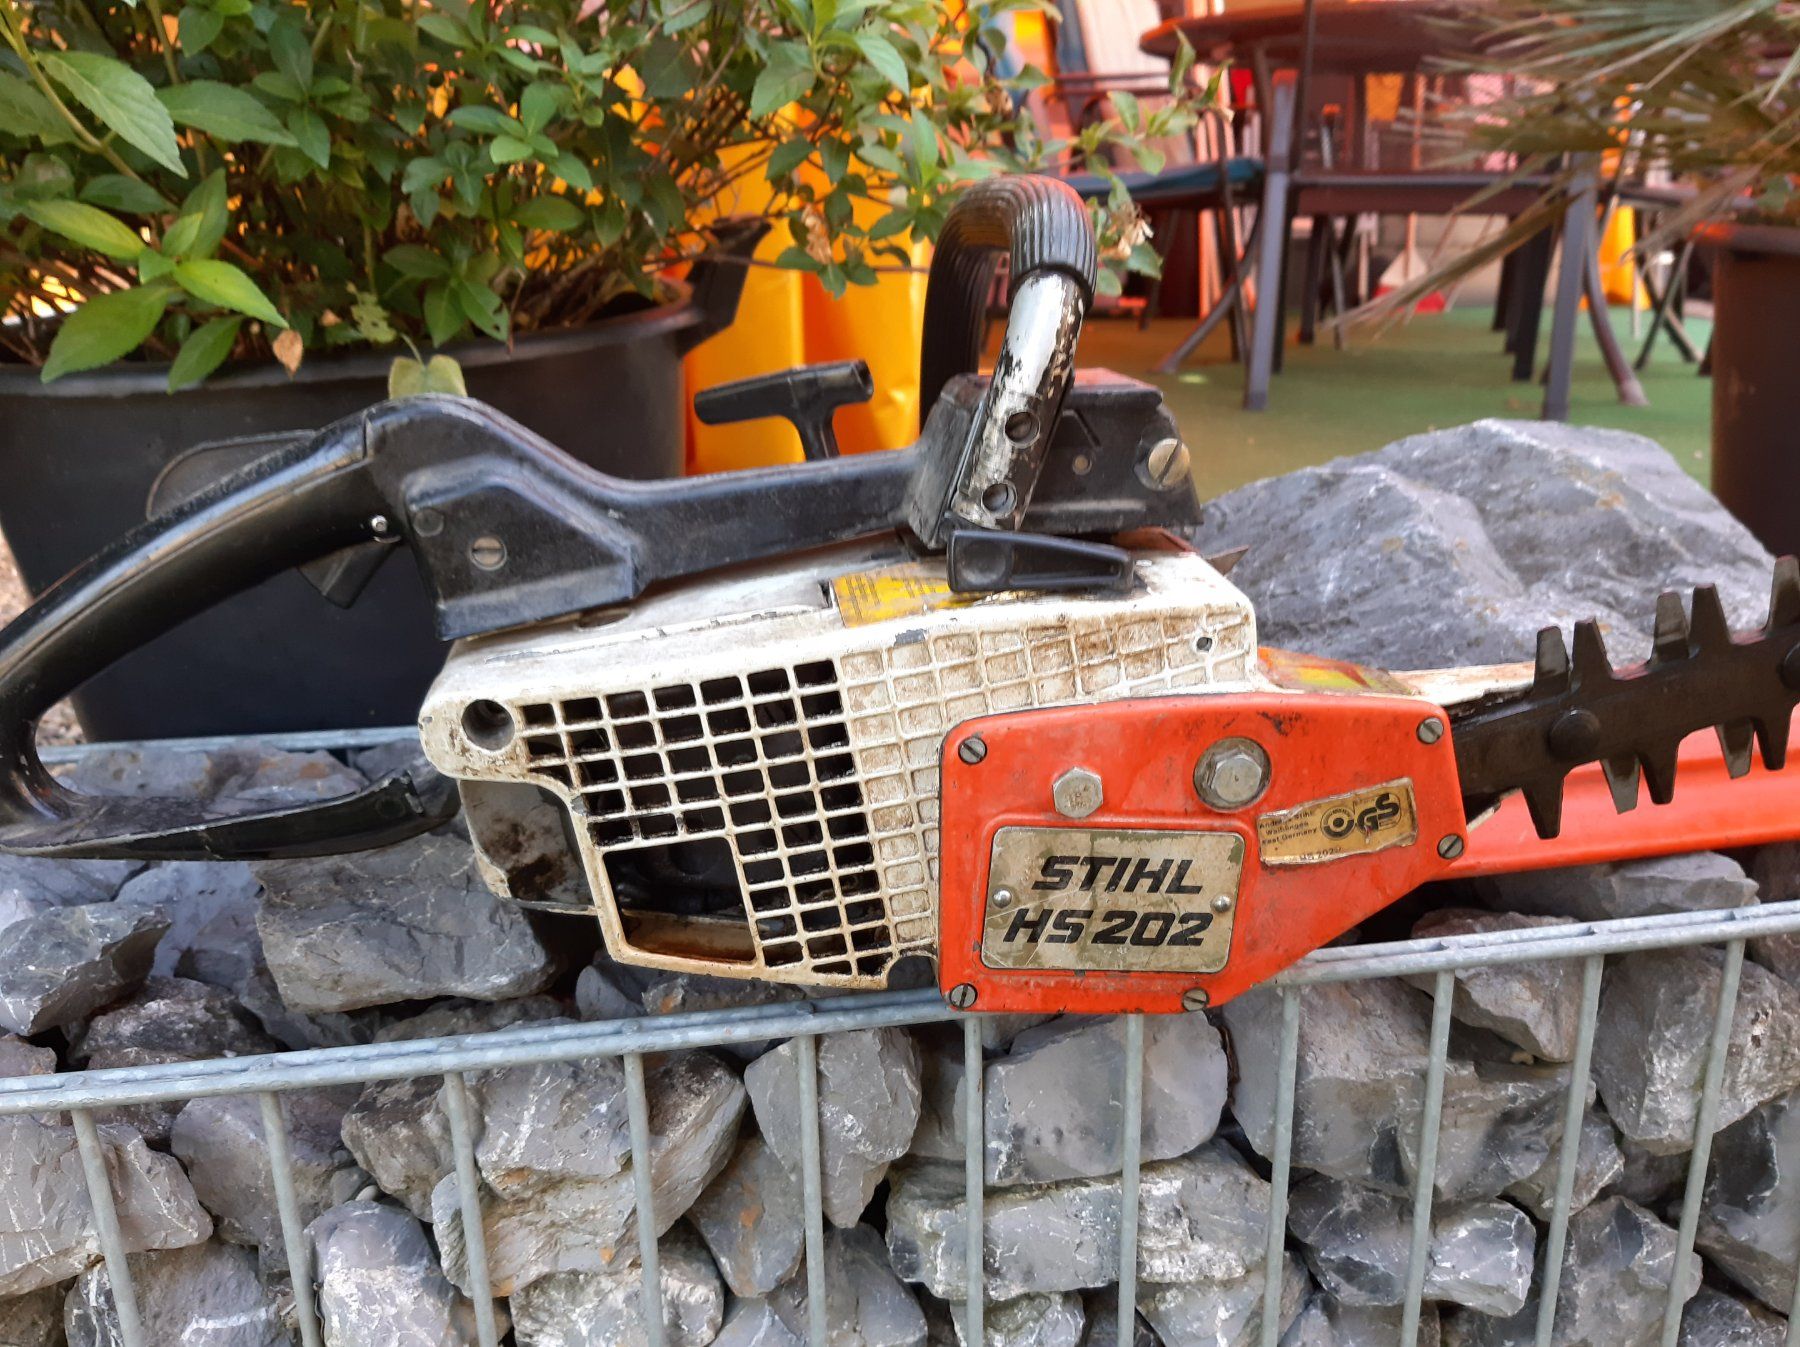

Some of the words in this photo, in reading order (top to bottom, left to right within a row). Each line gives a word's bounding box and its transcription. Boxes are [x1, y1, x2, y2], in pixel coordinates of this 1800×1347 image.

[1259, 816, 1292, 829] Andres
[1031, 855, 1203, 894] STIHL
[1003, 908, 1093, 944] HS
[1091, 910, 1214, 946] 202
